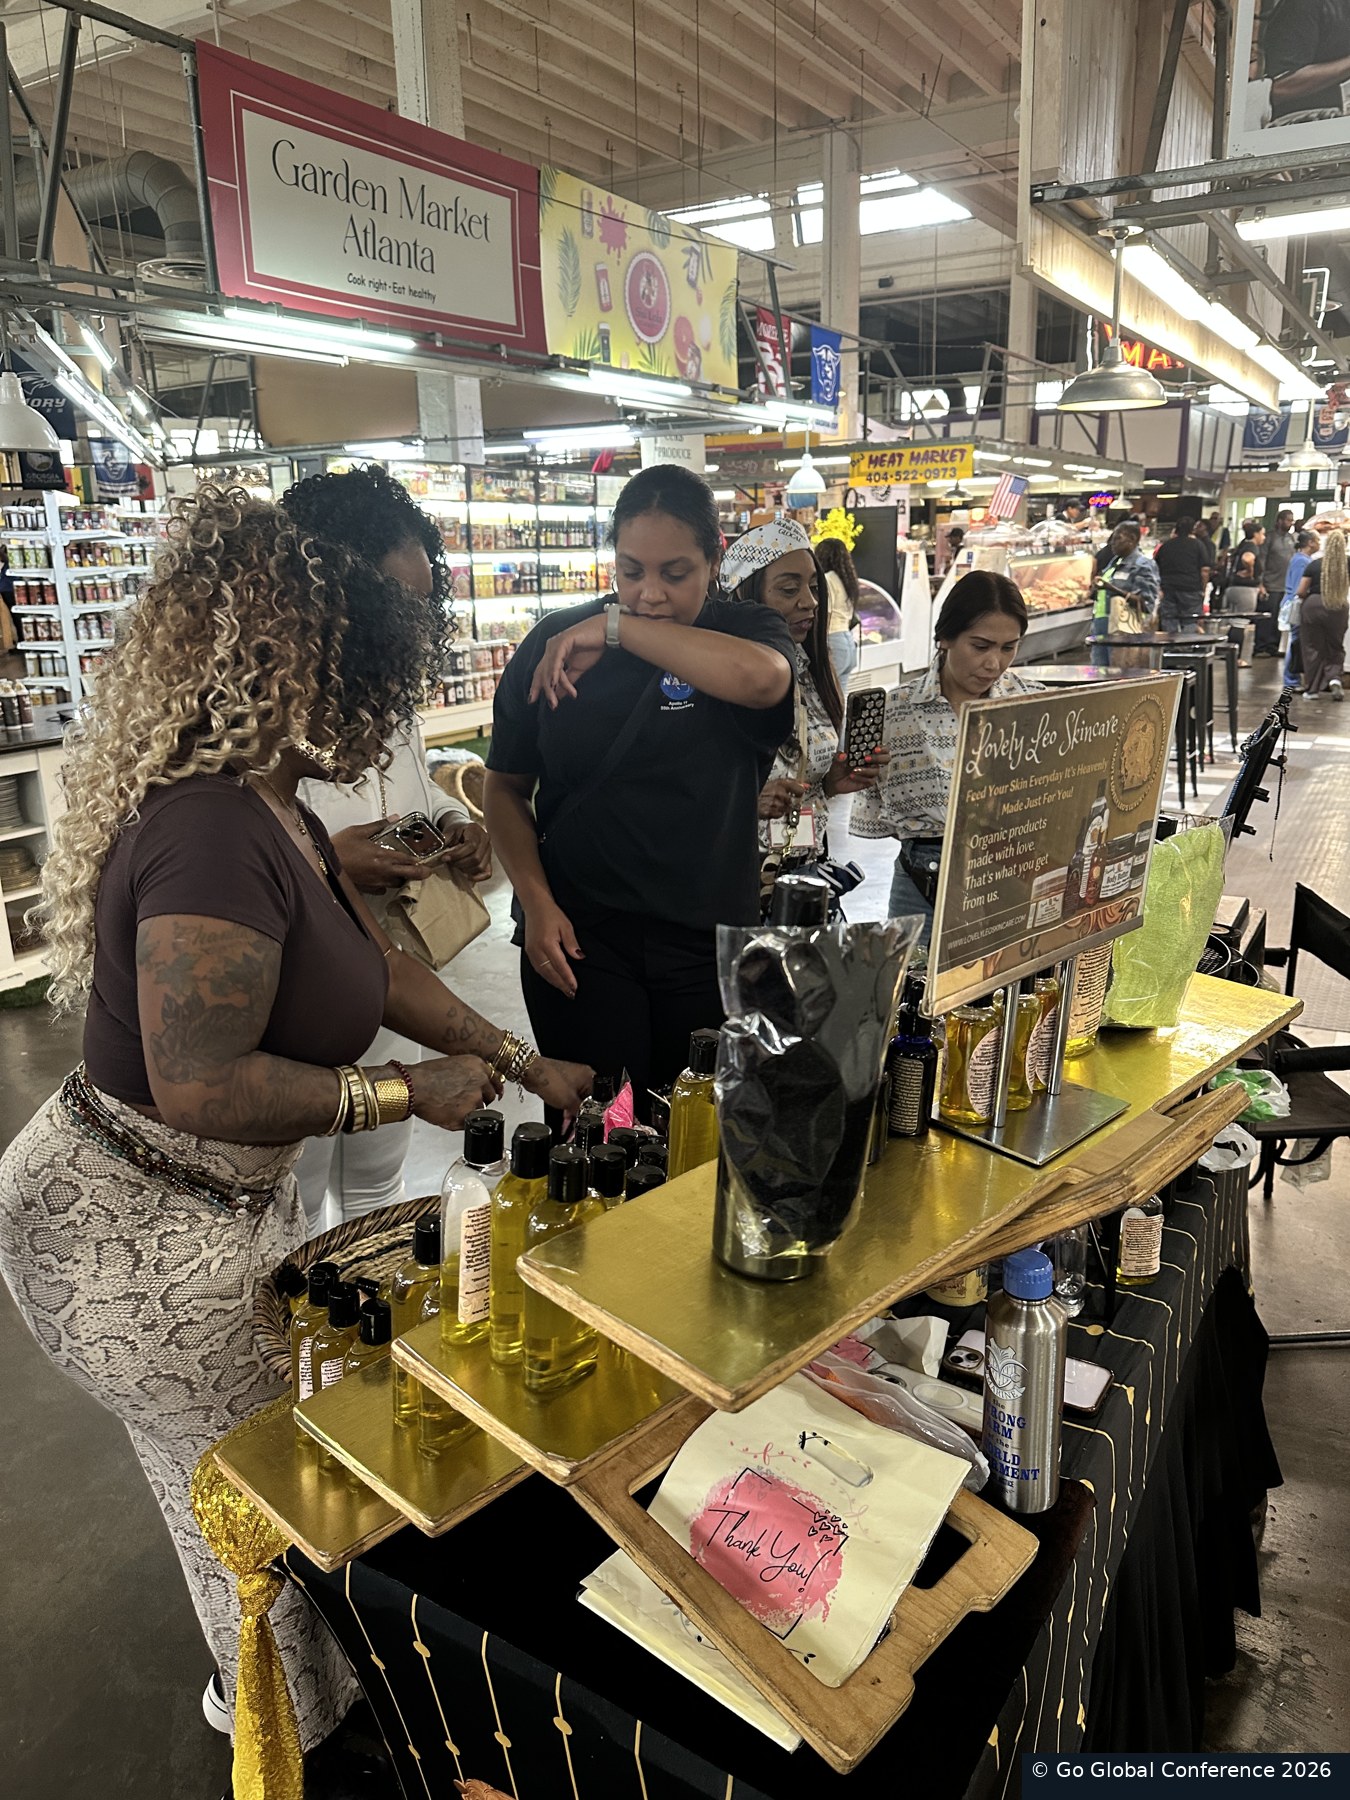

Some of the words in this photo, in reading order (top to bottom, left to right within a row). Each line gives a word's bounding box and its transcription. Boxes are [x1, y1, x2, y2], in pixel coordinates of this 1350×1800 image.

[271, 139, 389, 214] Garden
[398, 176, 491, 243] Market
[343, 213, 436, 274] Atlanta
[347, 272, 366, 286] Cook
[408, 285, 437, 304] healthy
[657, 446, 692, 459] PRODUCE
[867, 452, 905, 469] MEAT
[909, 448, 967, 466] MARKET
[1088, 495, 1113, 506] OPEN
[773, 519, 793, 531] Global
[965, 720, 1023, 777] Lovely
[1025, 712, 1058, 764] Leo
[1058, 707, 1119, 757] Skincare
[965, 787, 987, 803] Feed
[987, 782, 1010, 797] Your
[1009, 779, 1028, 793] Skin
[1028, 771, 1063, 789] Everyday
[1064, 767, 1076, 779] It's
[1076, 759, 1109, 776] Heavenly
[1001, 800, 1023, 816] Made
[1024, 796, 1041, 809] Just
[1042, 792, 1057, 805] For
[1057, 787, 1074, 800] You!
[970, 827, 1008, 851] Organic
[1008, 818, 1048, 841] products
[966, 855, 994, 871] made
[995, 846, 1015, 861] with
[1016, 840, 1036, 856] love.
[964, 872, 993, 891] That's
[994, 864, 1017, 881] what
[1017, 859, 1034, 878] you
[1034, 853, 1049, 873] get
[1106, 875, 1117, 886] Body
[962, 892, 986, 912] from
[986, 889, 1000, 903] us.
[947, 914, 1027, 950] WWW.LOVELYLEOSKINCARE.COM
[993, 1398, 1005, 1409] the
[996, 1436, 1010, 1449] the
[706, 1508, 761, 1562] Thank
[759, 1530, 833, 1593] You!
